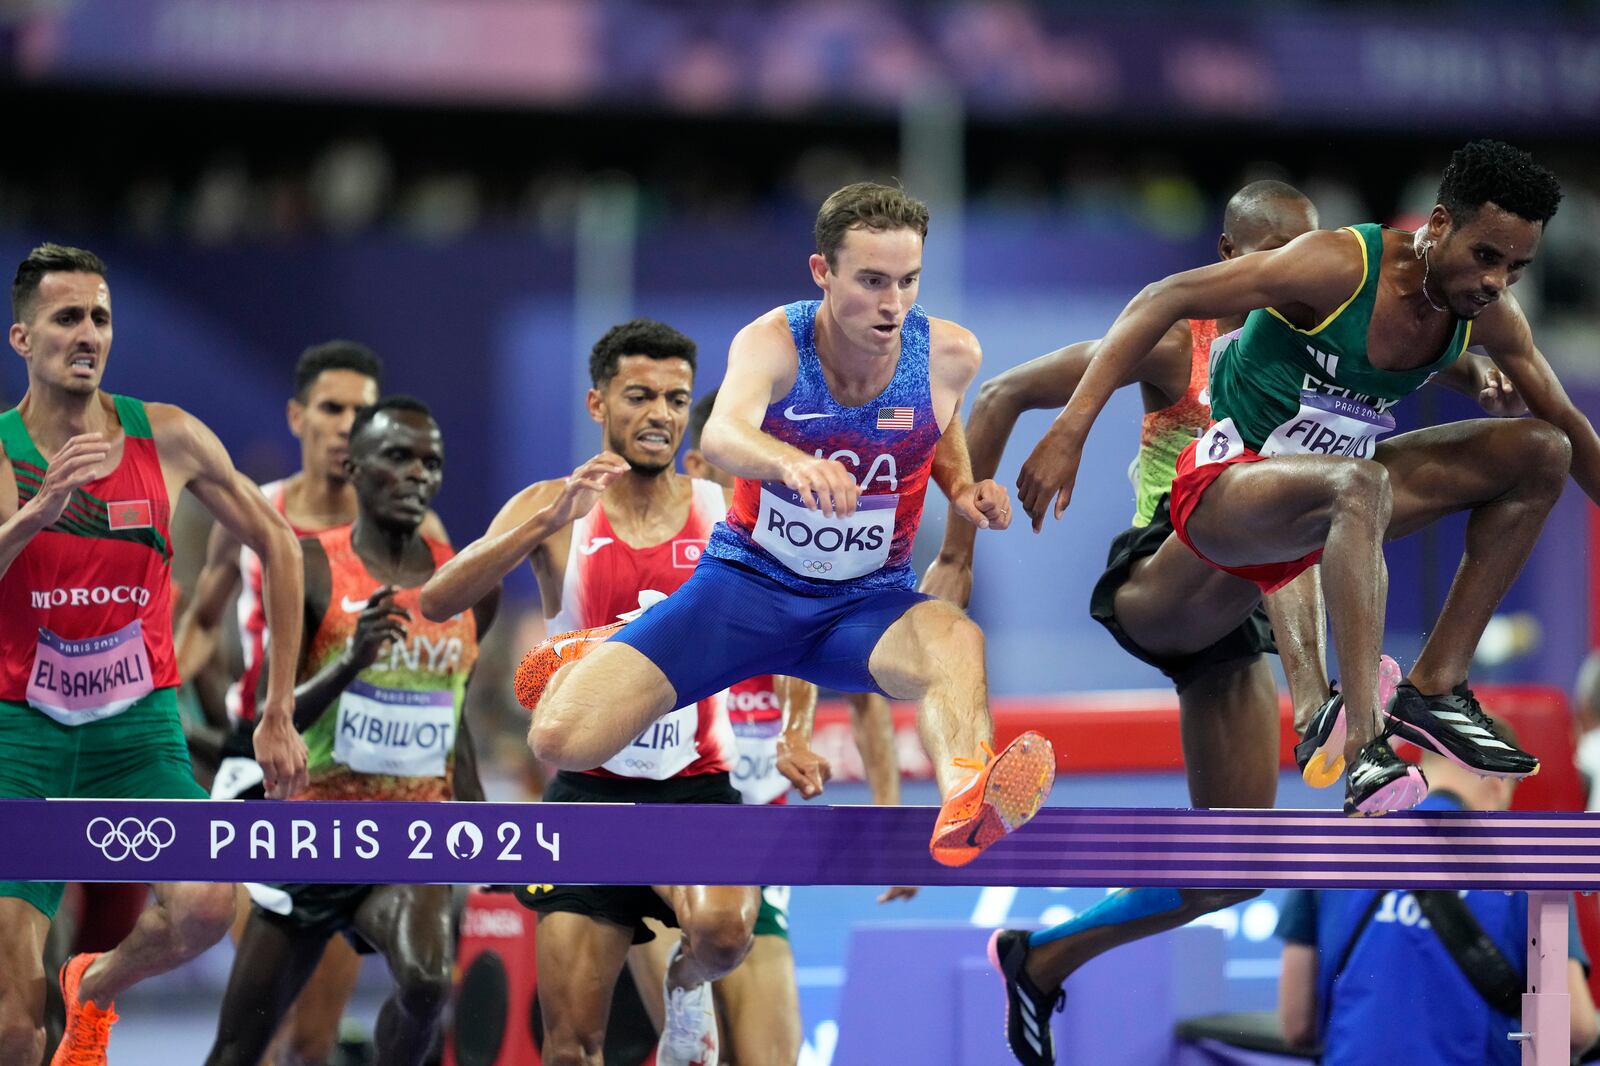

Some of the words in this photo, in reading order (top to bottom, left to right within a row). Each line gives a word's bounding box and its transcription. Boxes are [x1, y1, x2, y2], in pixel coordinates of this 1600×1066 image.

[1335, 400, 1360, 415] PARIS
[1208, 430, 1230, 461] 8
[785, 442, 898, 491] SA
[767, 507, 884, 552] ROOKS
[31, 585, 150, 609] MOROCCO
[60, 642, 90, 653] PARIS
[346, 634, 463, 673] ENYA
[34, 659, 57, 692] EL
[61, 654, 144, 697] BAKKALI
[340, 709, 450, 750] KIBIWOT
[209, 819, 380, 860] PARIS
[407, 820, 560, 862] 2024
